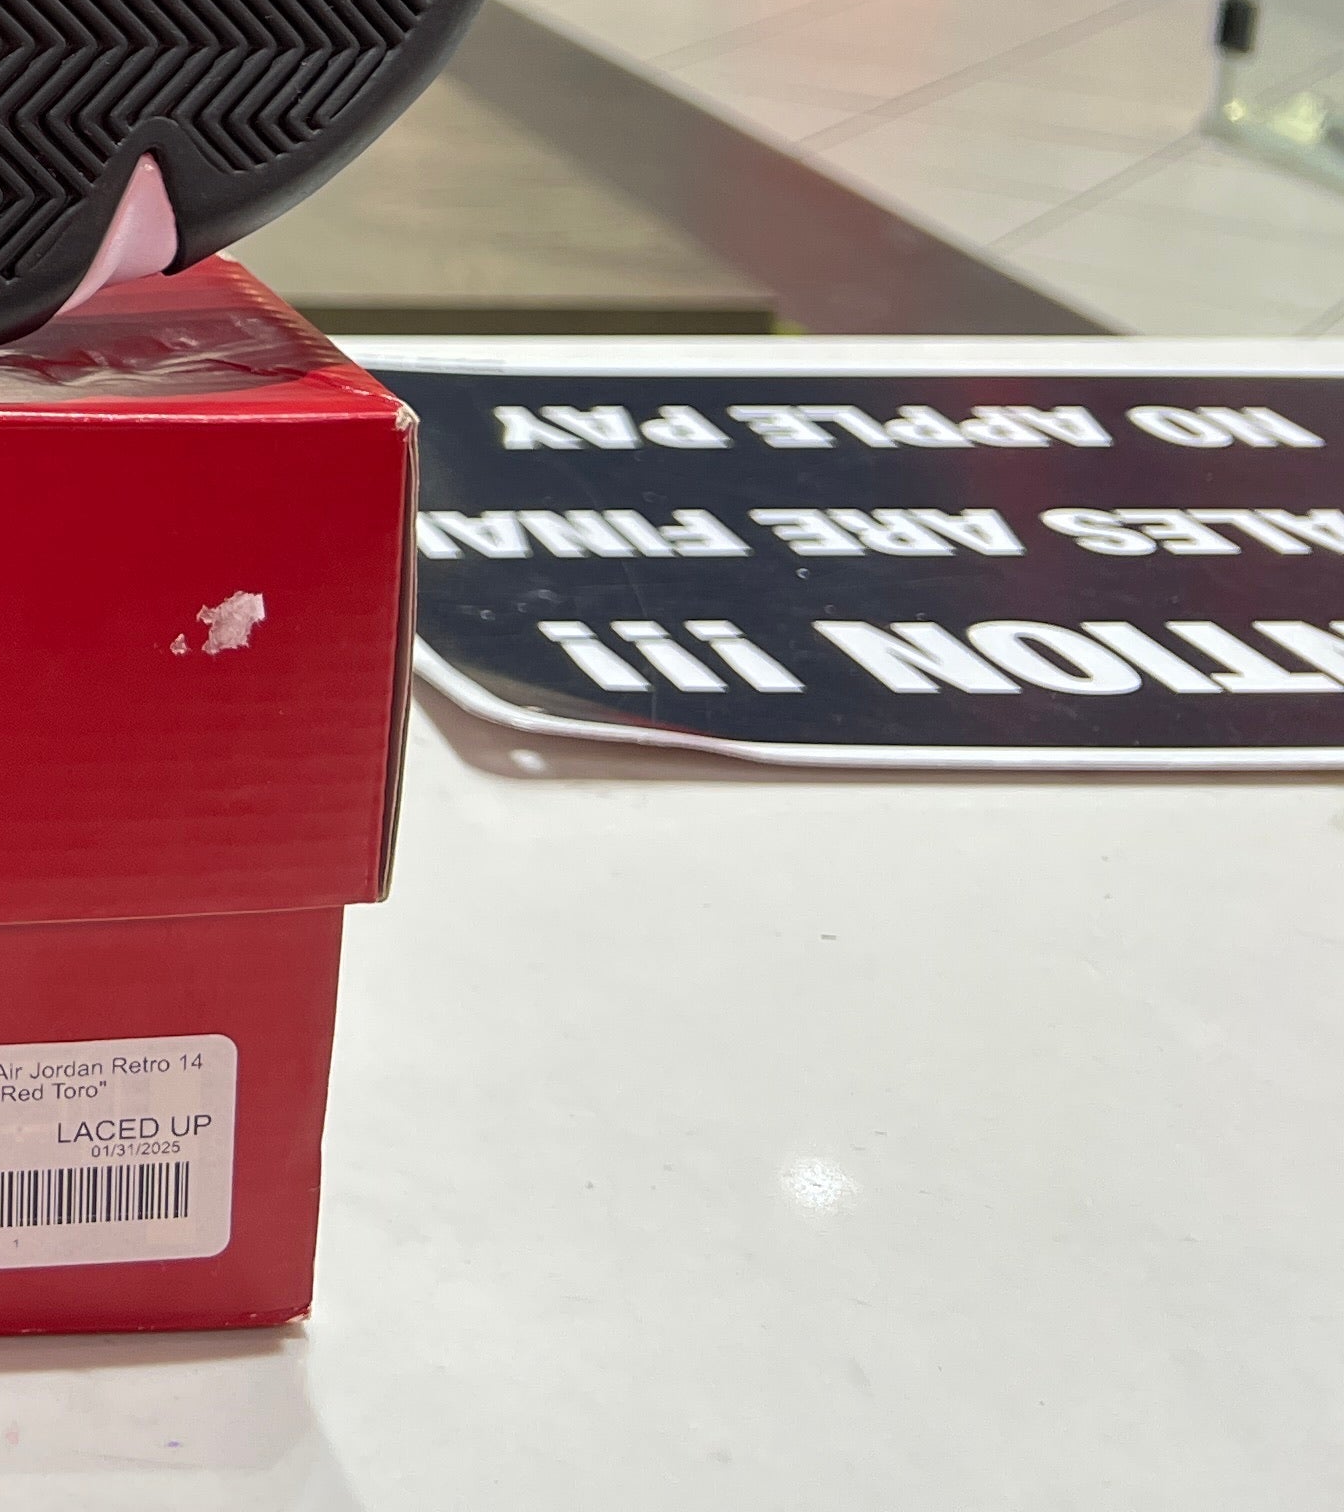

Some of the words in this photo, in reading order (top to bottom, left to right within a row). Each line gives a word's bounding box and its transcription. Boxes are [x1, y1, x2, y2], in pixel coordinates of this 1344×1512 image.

[494, 404, 735, 450] PAY
[726, 404, 1113, 449] APPLE
[1125, 405, 1326, 448] NO
[748, 508, 1026, 557] ARE
[30, 1060, 103, 1080] Jordan
[112, 1056, 170, 1075] Retro
[179, 1053, 203, 1070] 14
[1, 1084, 43, 1102] Red
[52, 1080, 107, 1100] Toro"
[58, 1117, 159, 1144] LACED
[171, 1115, 212, 1137] UP
[91, 1141, 180, 1158] 01/31/2025
